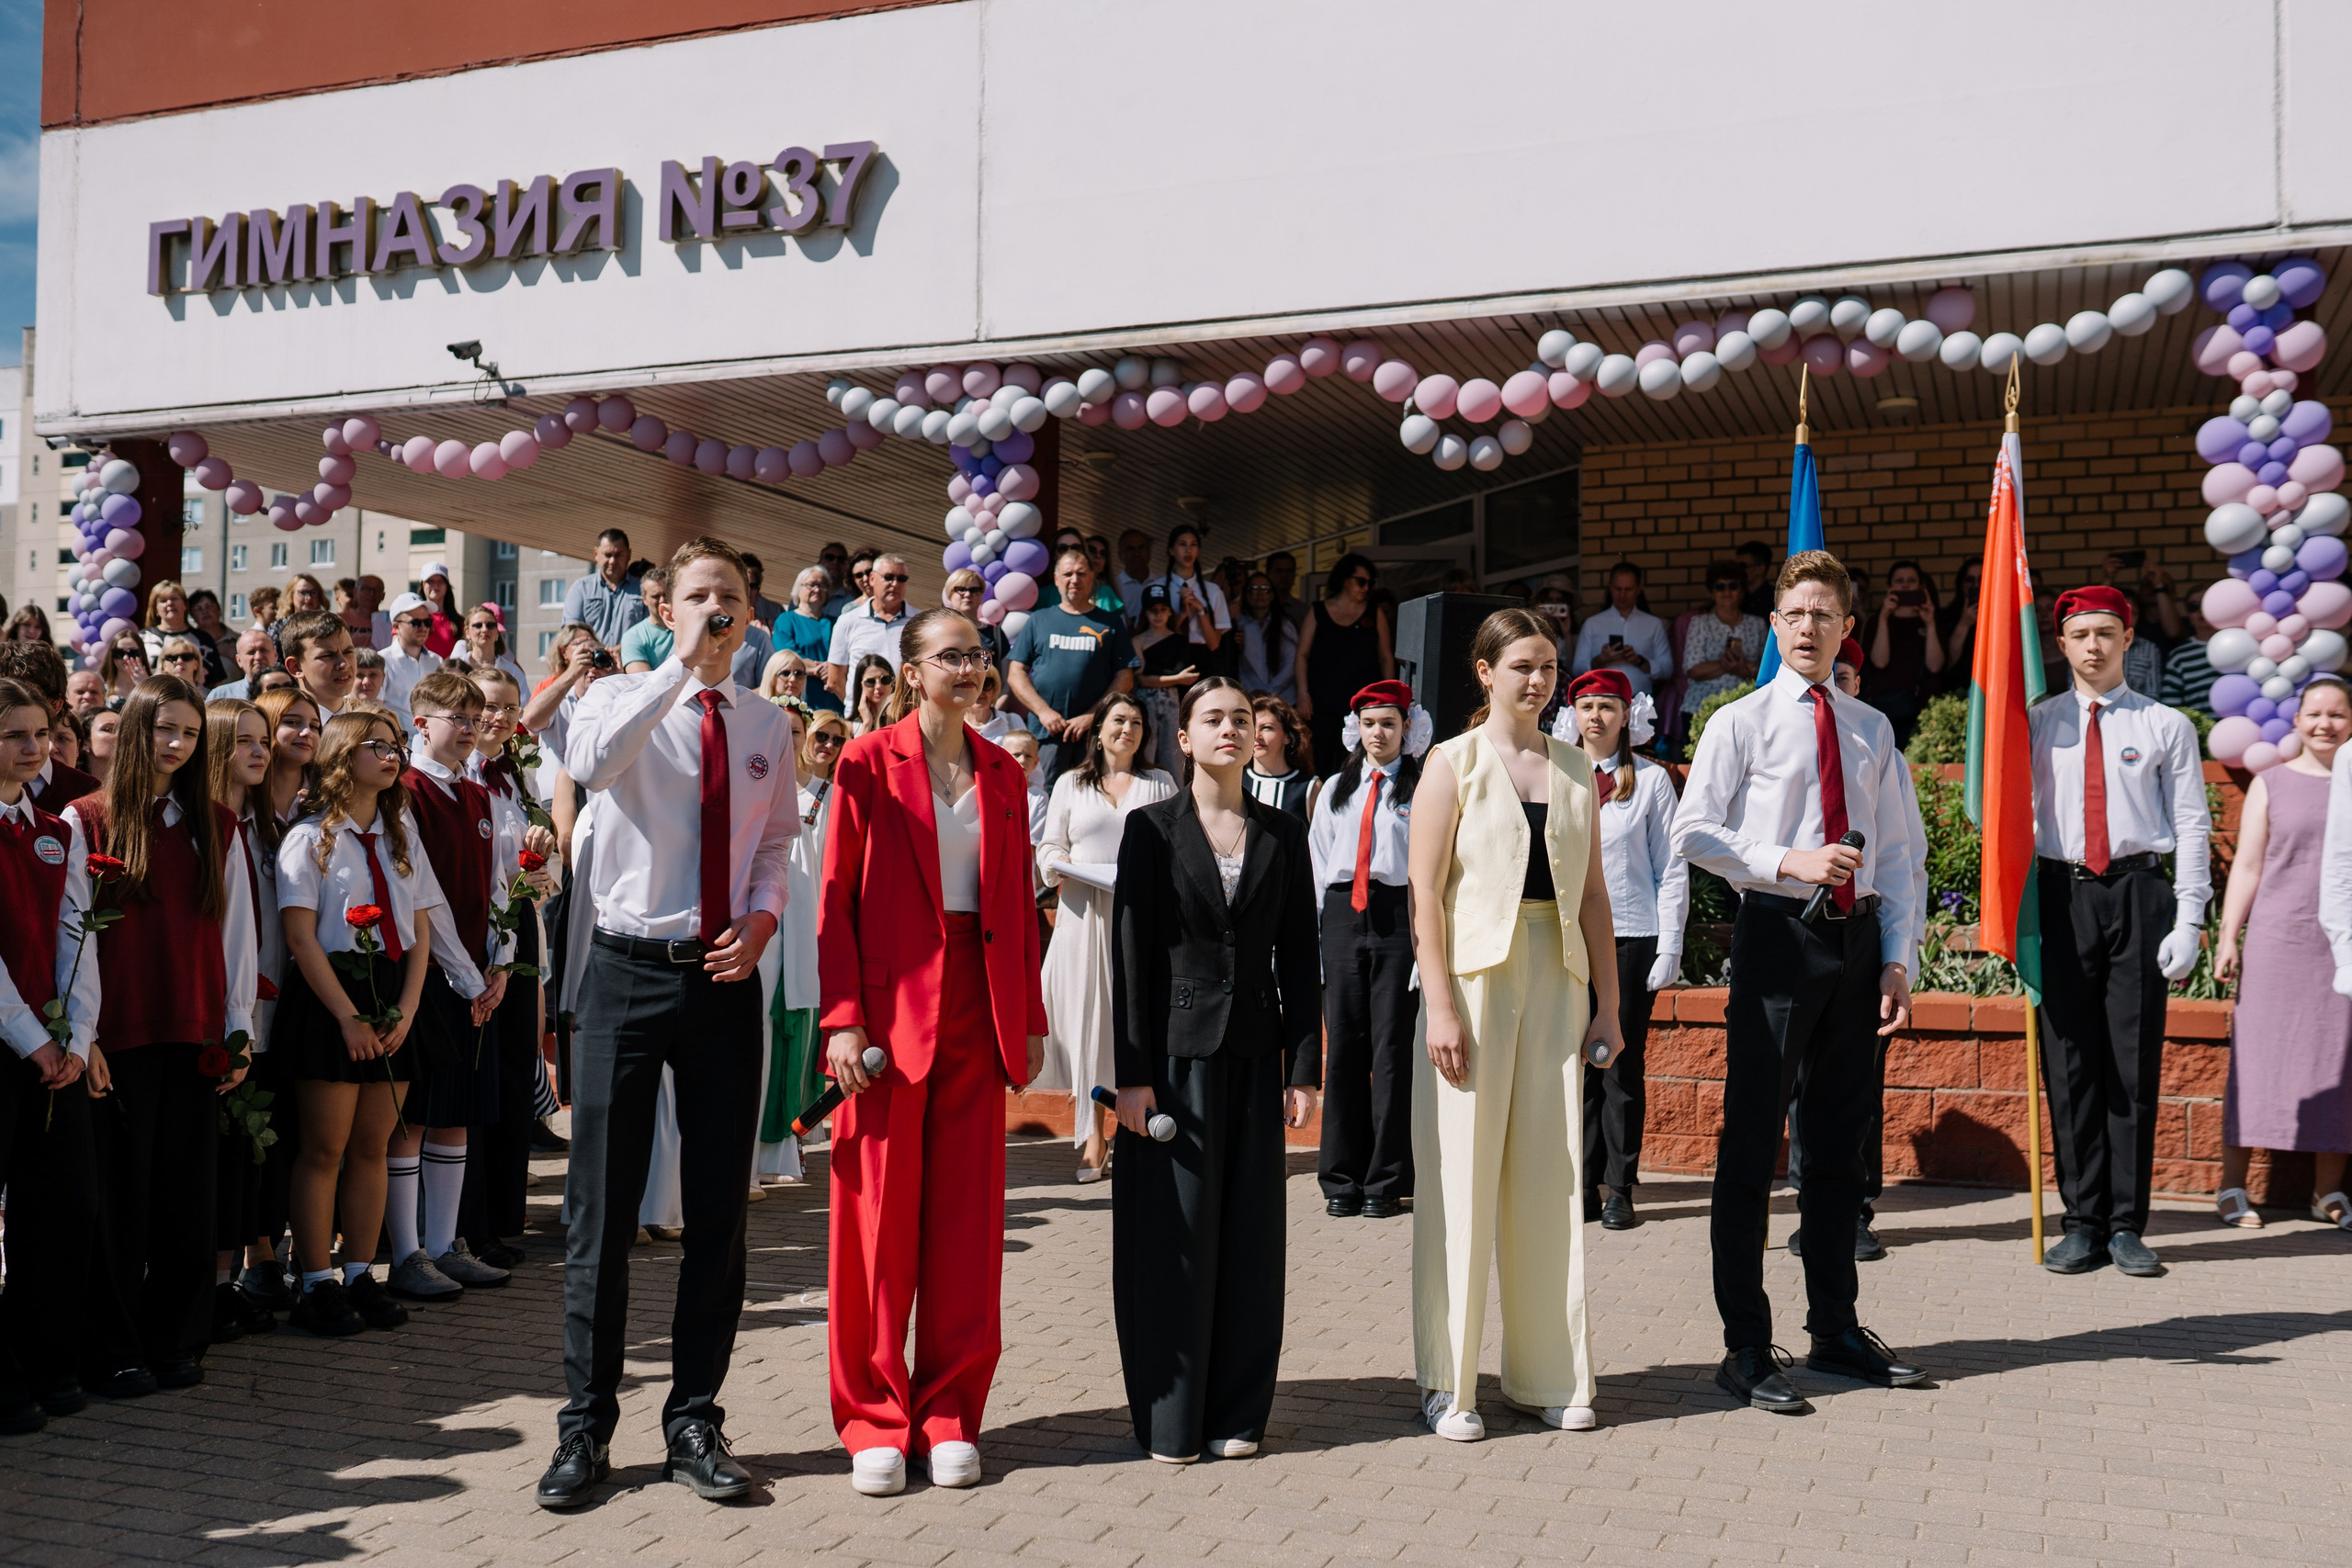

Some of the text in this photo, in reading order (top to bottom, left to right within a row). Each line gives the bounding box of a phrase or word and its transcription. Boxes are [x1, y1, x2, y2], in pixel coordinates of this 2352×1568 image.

[148, 140, 879, 297] ГИМНАЗИЯ №37
[1049, 633, 1096, 651] PUMA
